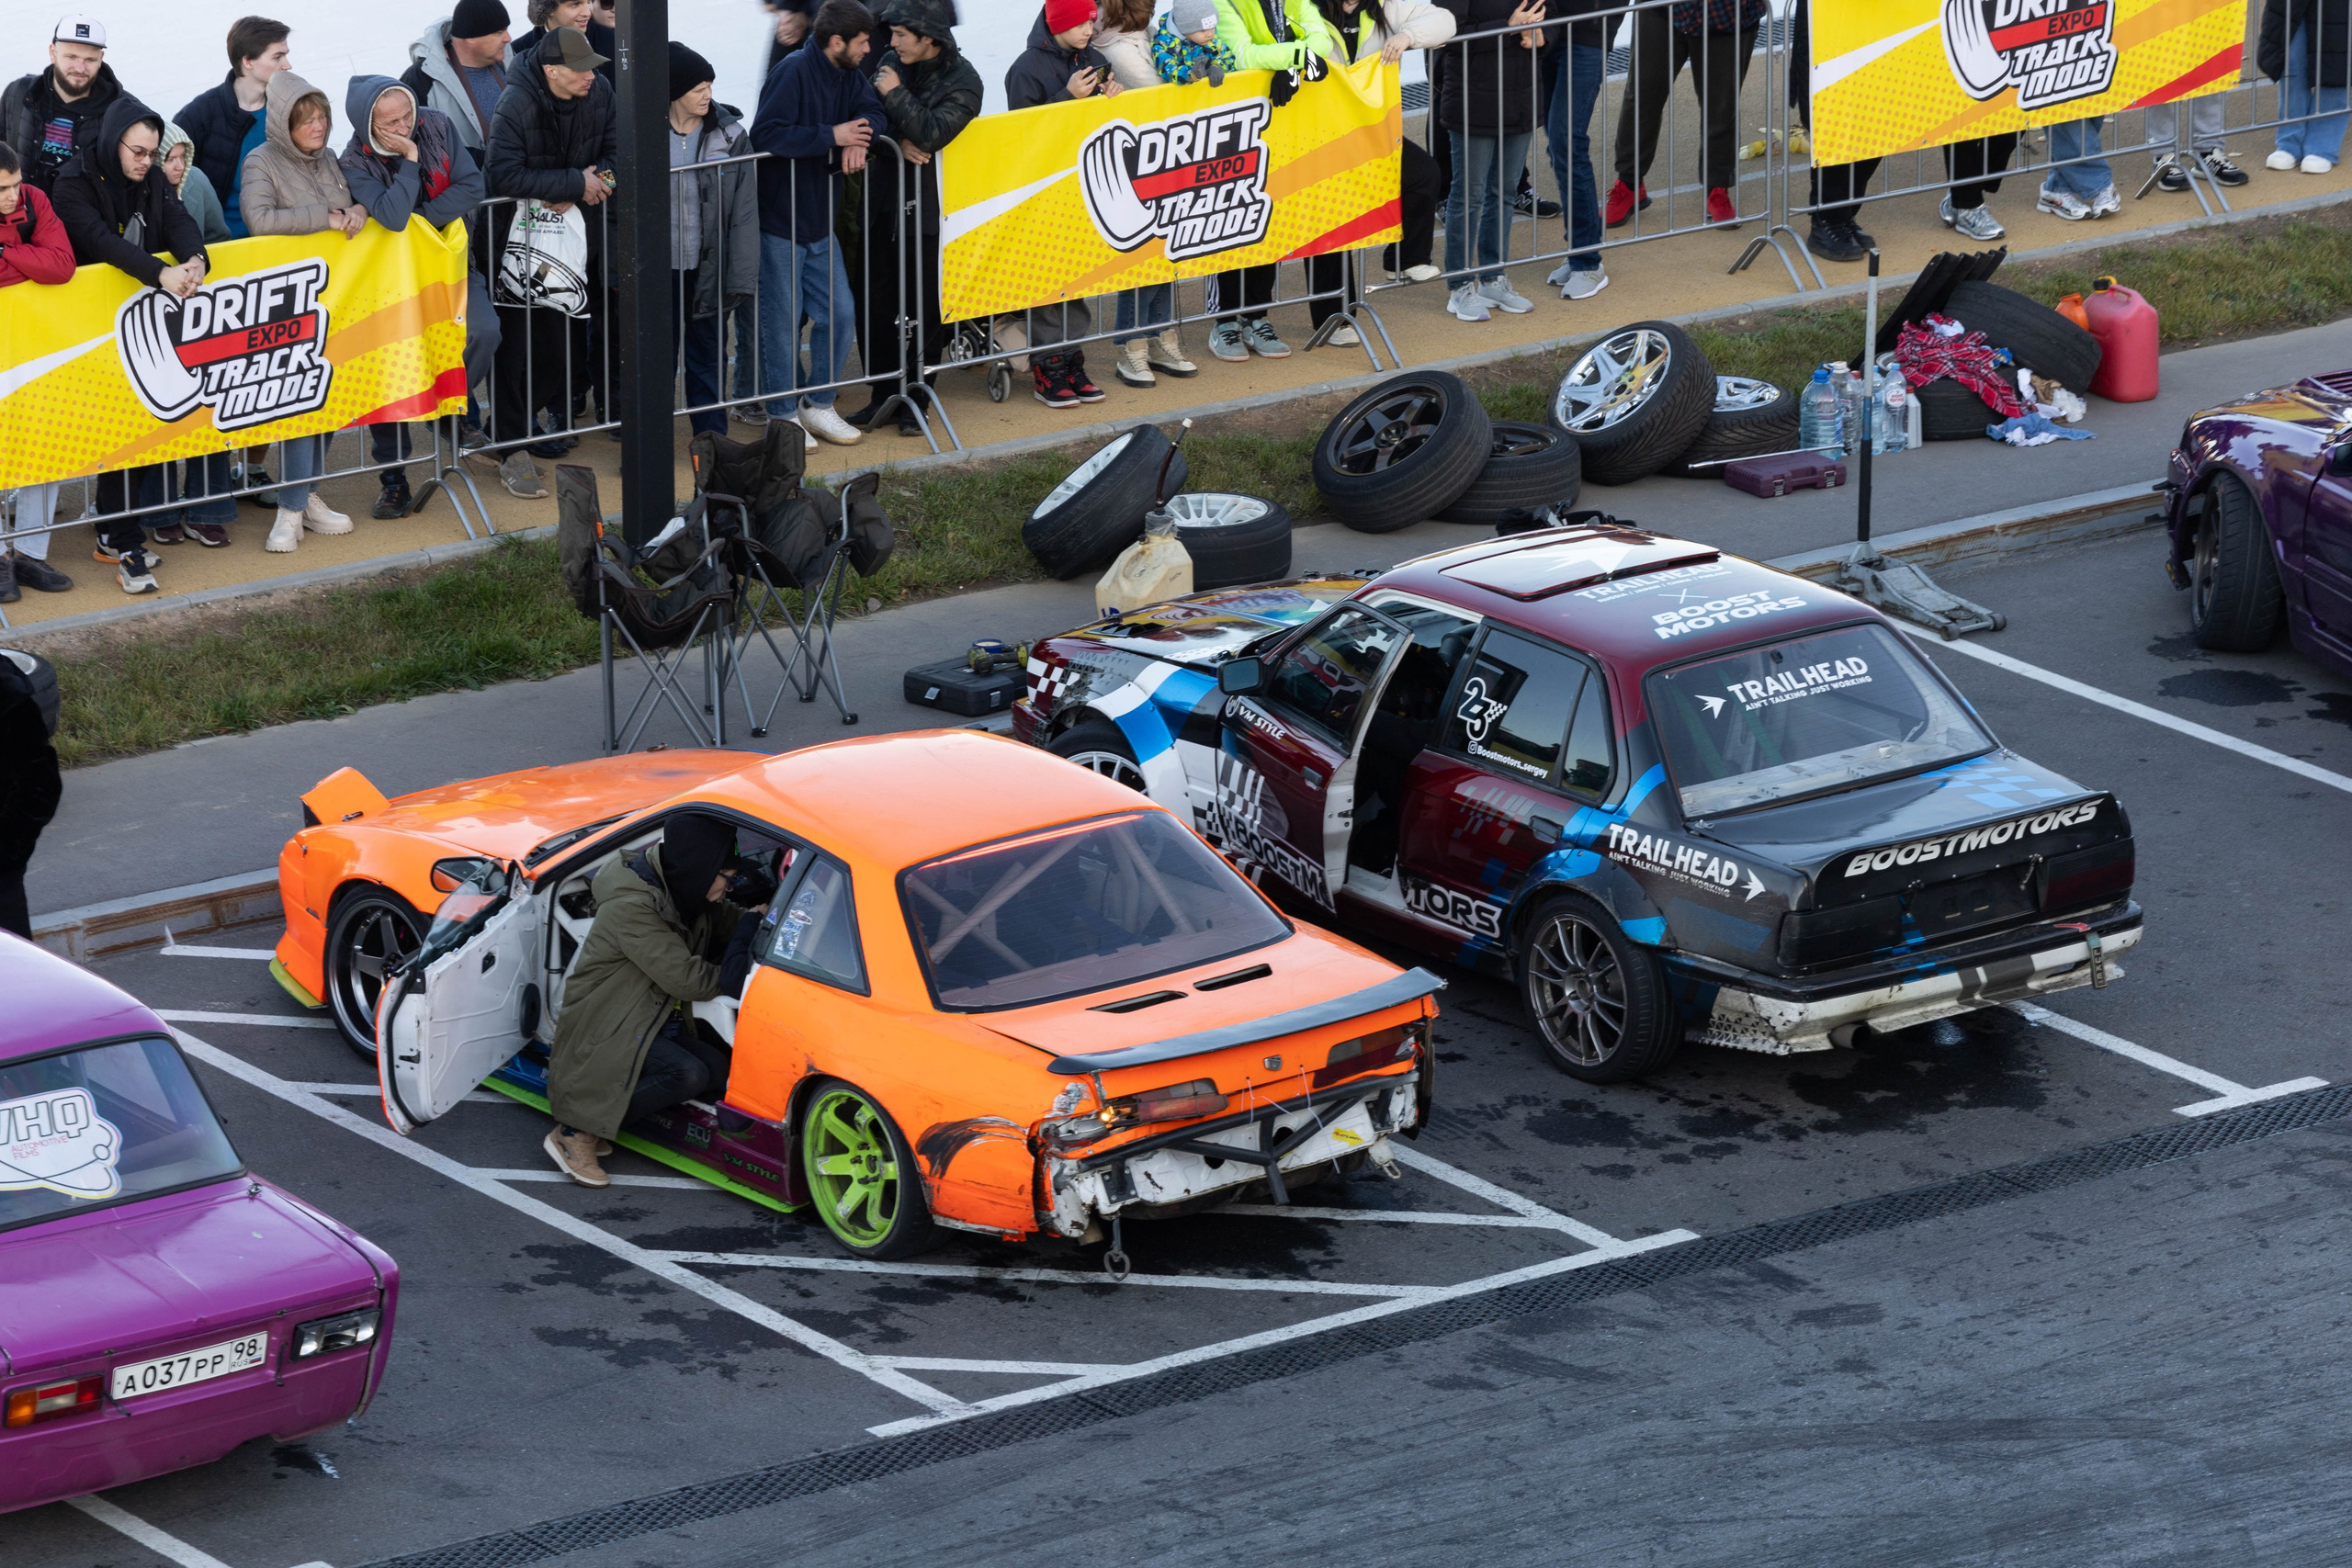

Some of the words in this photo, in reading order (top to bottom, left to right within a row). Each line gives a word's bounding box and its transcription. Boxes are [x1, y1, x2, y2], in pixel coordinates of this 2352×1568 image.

[2048, 9, 2095, 36] EXPO
[2013, 28, 2103, 75] TRACK
[2024, 51, 2111, 98] MODE
[1137, 107, 1261, 175] DRIFT
[1195, 156, 1245, 183] EXPO
[1159, 177, 1255, 225] TRACK
[1172, 202, 1262, 249] MODE
[182, 268, 318, 343] DRIFT
[247, 320, 301, 349] EXPO
[204, 342, 315, 393] TRACK
[221, 367, 322, 419] MODE
[1575, 563, 1724, 600] TRAILHEAD
[1651, 590, 1770, 626] BOOST
[1654, 596, 1808, 639] MOTORS
[1726, 657, 1869, 704] TRAILHEAD
[1746, 697, 1769, 712] AIN'T
[1770, 689, 1808, 705] TALKING
[1809, 683, 1831, 695] JUST
[1832, 675, 1873, 691] WORKING
[1238, 705, 1257, 722] VM
[1254, 716, 1285, 740] STYLE
[1609, 823, 1739, 886] TRAILHEAD
[1845, 797, 2106, 877] BOOSTMOTORS
[1631, 857, 1667, 876] TALKING
[1668, 870, 1690, 885] JUST
[1690, 876, 1731, 897] WORKING
[0, 1094, 89, 1145] HQ
[686, 1122, 711, 1144] ECU
[11, 1135, 69, 1153] AUTOMOTIVE
[13, 1149, 39, 1160] FILMS
[684, 1134, 709, 1151] MASTER
[723, 1152, 742, 1167] VM
[746, 1162, 780, 1183] STYLE
[231, 1358, 249, 1370] RUS
[234, 1338, 257, 1360] 98
